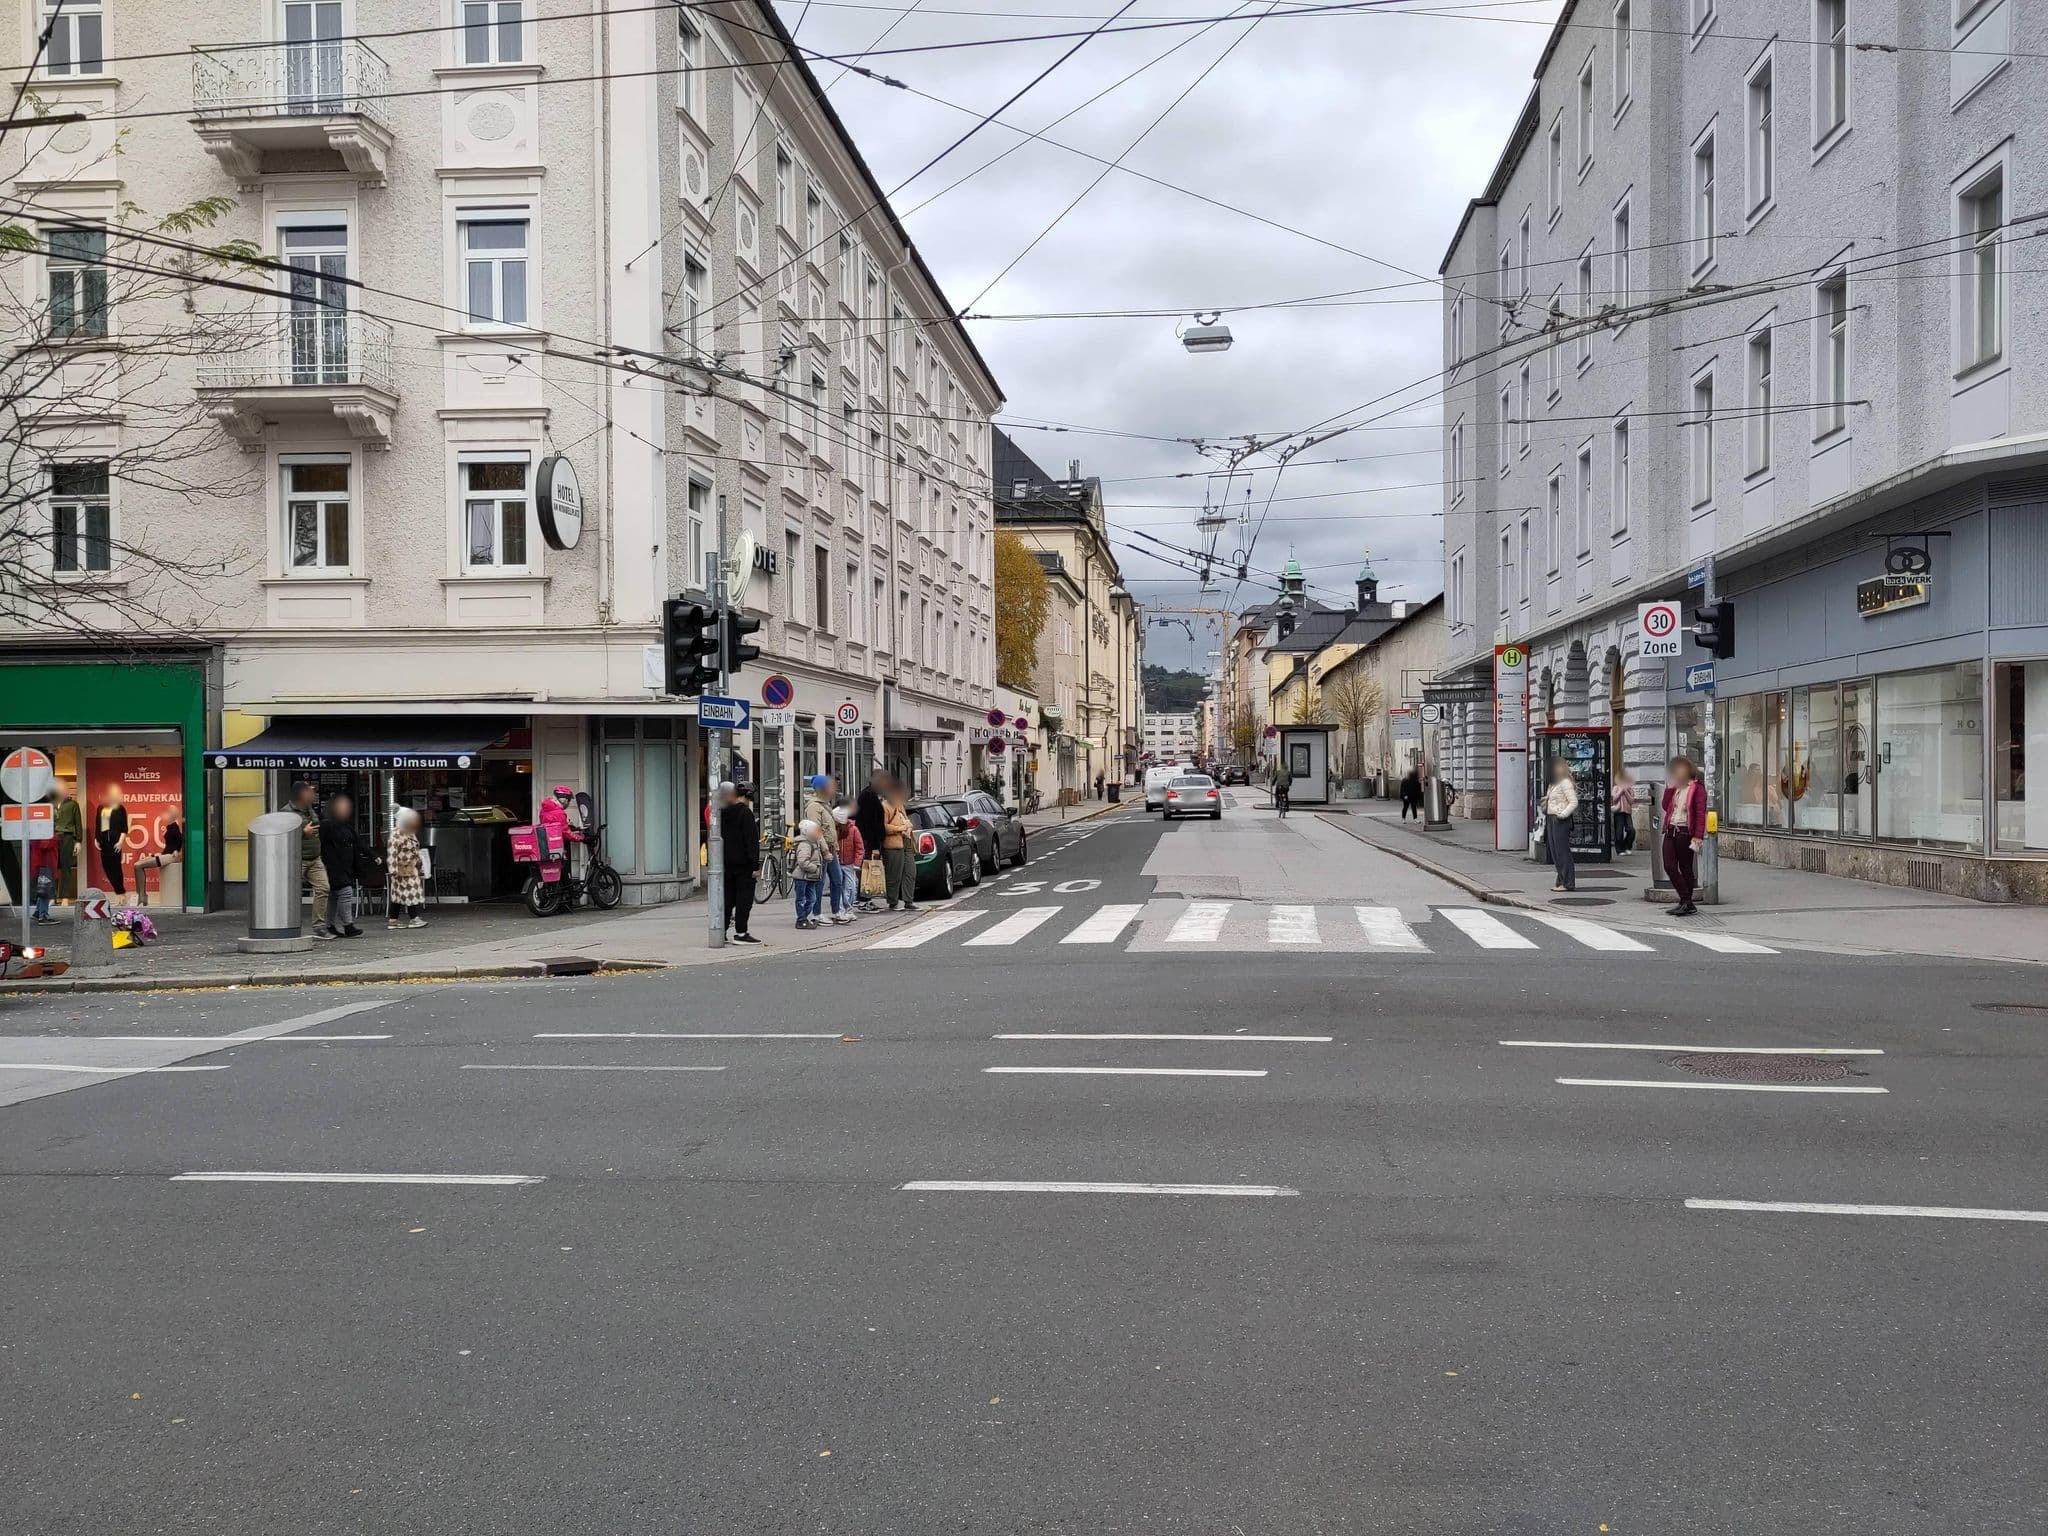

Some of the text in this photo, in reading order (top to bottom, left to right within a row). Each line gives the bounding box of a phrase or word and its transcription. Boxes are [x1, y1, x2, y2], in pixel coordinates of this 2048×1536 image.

[556, 484, 575, 503] HOTEL
[753, 541, 780, 575] OTEL
[1651, 614, 1668, 630] 30
[1643, 641, 1677, 655] Zone
[703, 704, 734, 719] EINBAHN
[842, 708, 855, 721] 30
[838, 726, 861, 737] Zone
[236, 757, 448, 768] Lamian Wok Sushi Dimsum
[124, 772, 161, 780] PALMERS
[996, 879, 1103, 896] 30
